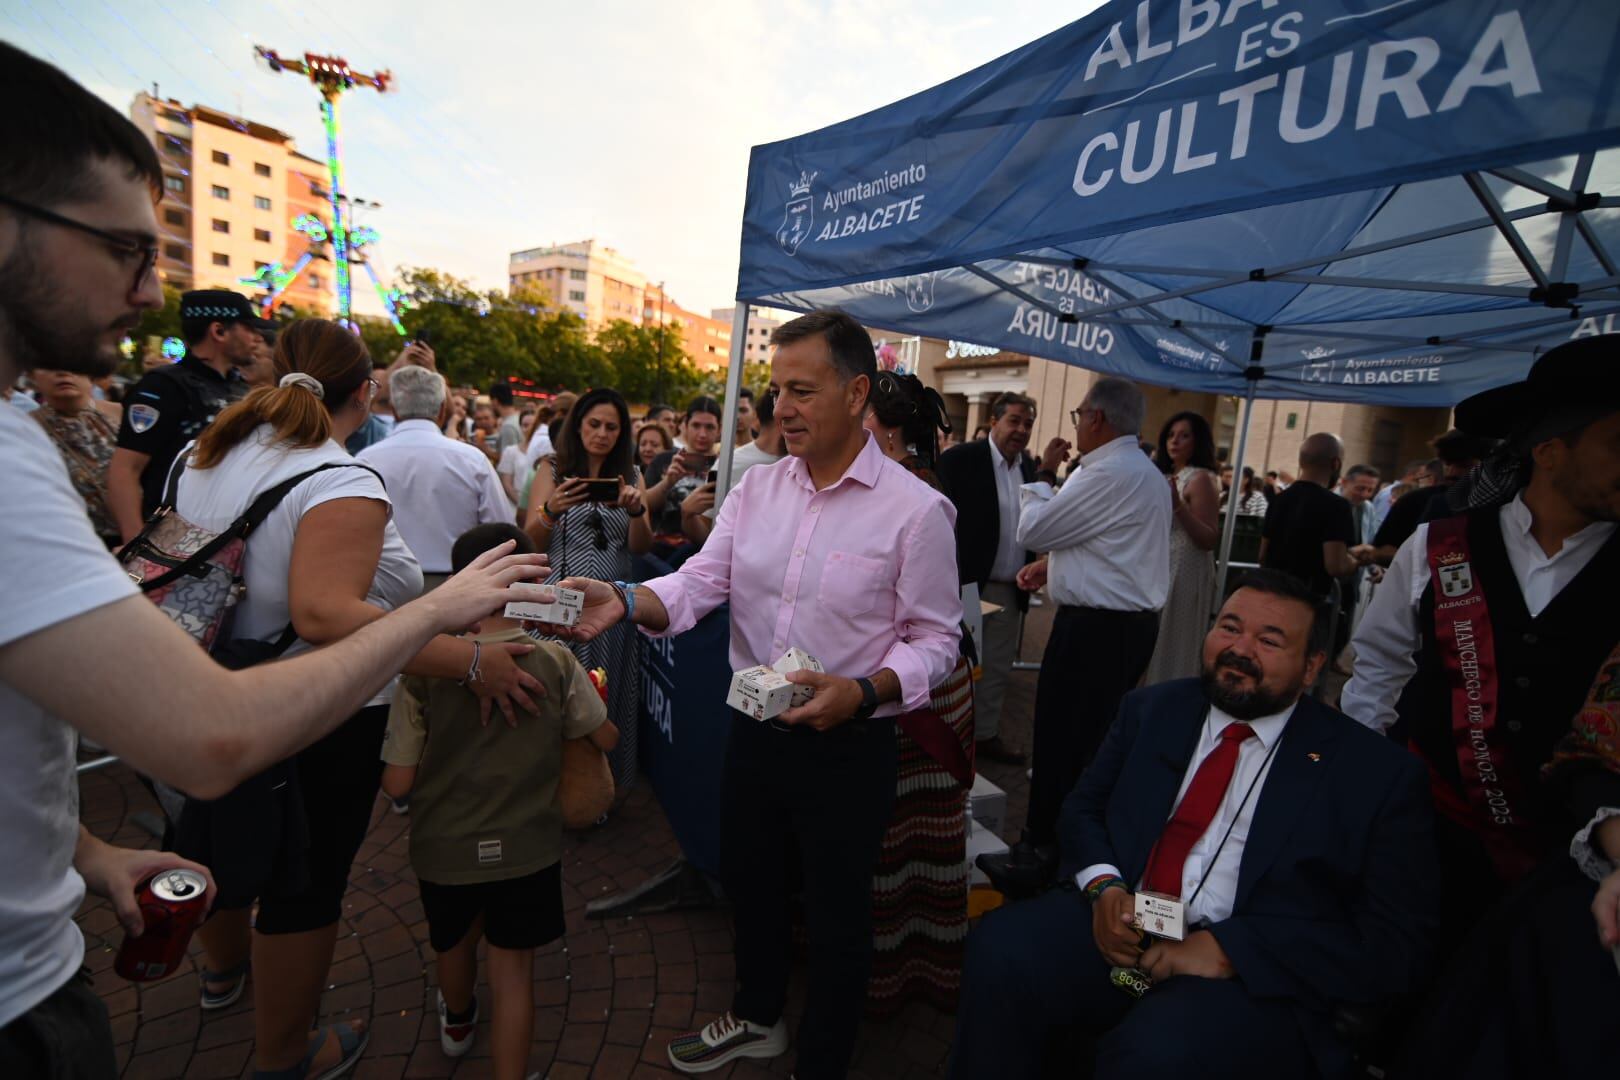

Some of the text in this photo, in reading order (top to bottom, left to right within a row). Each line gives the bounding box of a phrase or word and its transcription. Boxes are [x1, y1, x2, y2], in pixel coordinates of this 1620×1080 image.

[1234, 11, 1304, 73] ES
[1072, 9, 1543, 197] CULTURA
[822, 163, 926, 214] Ayuntamiento
[815, 194, 926, 242] ALBACETE
[1342, 367, 1441, 385] ALBACETE
[1345, 354, 1443, 370] Ayuntamiento
[1437, 595, 1482, 610] ALBACETE
[1453, 619, 1513, 825] MANCHEGO DE HONOR 2025
